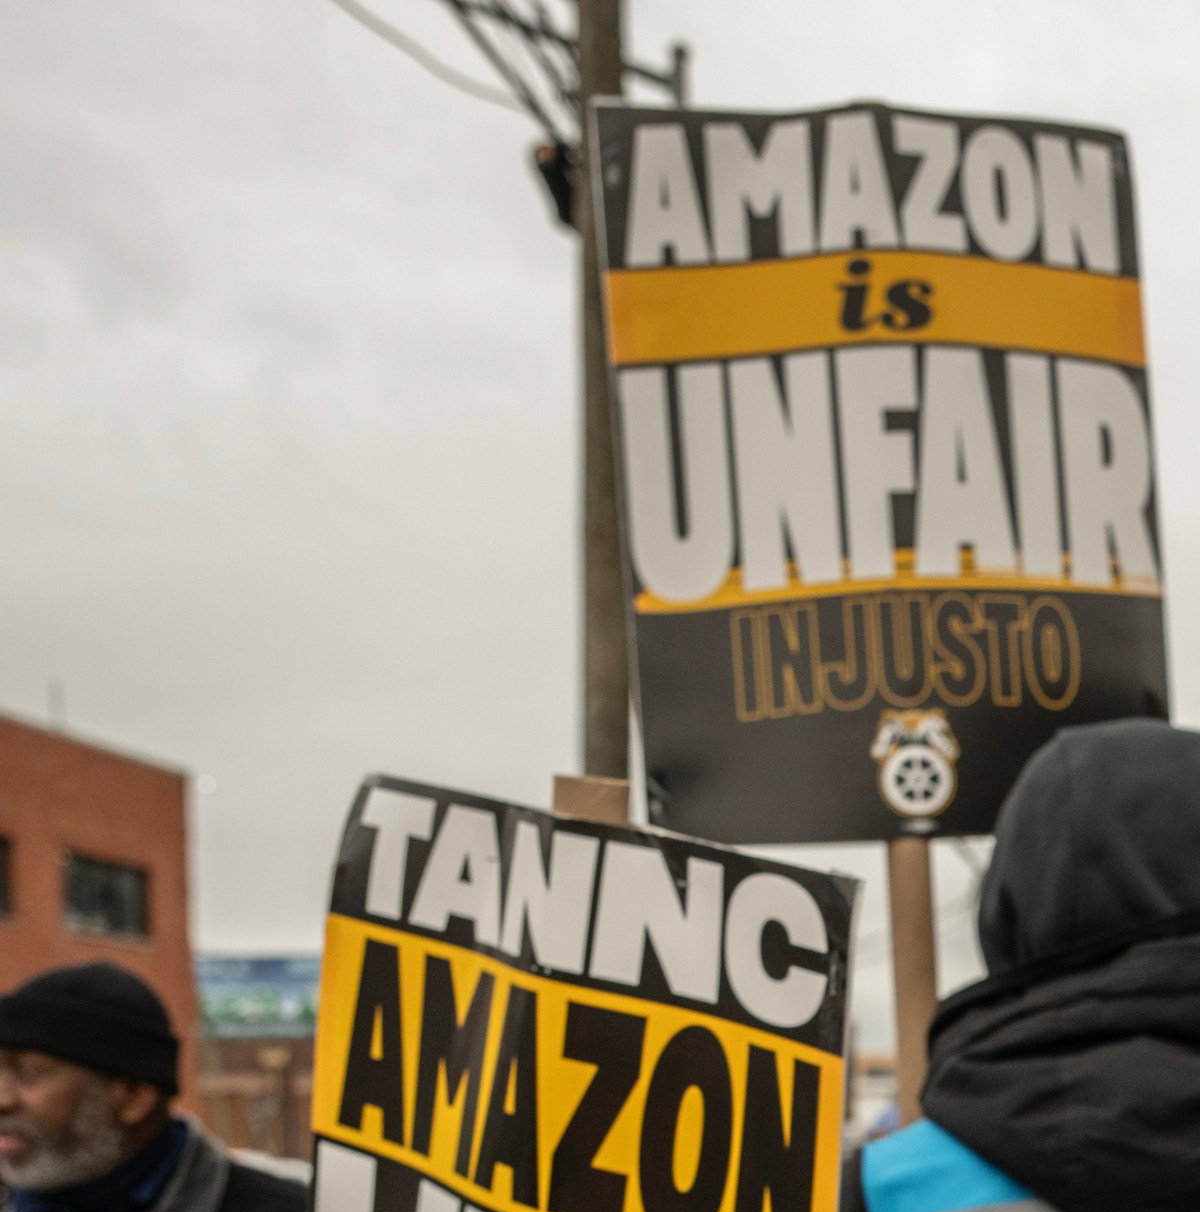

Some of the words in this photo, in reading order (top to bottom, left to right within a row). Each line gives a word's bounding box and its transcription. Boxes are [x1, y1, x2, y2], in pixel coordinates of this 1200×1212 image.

[624, 110, 1122, 274] AMAZON
[837, 259, 935, 332] is
[618, 345, 1163, 602] UNFAIR
[730, 591, 1081, 722] INJUSTO
[359, 787, 829, 1028] TANNC
